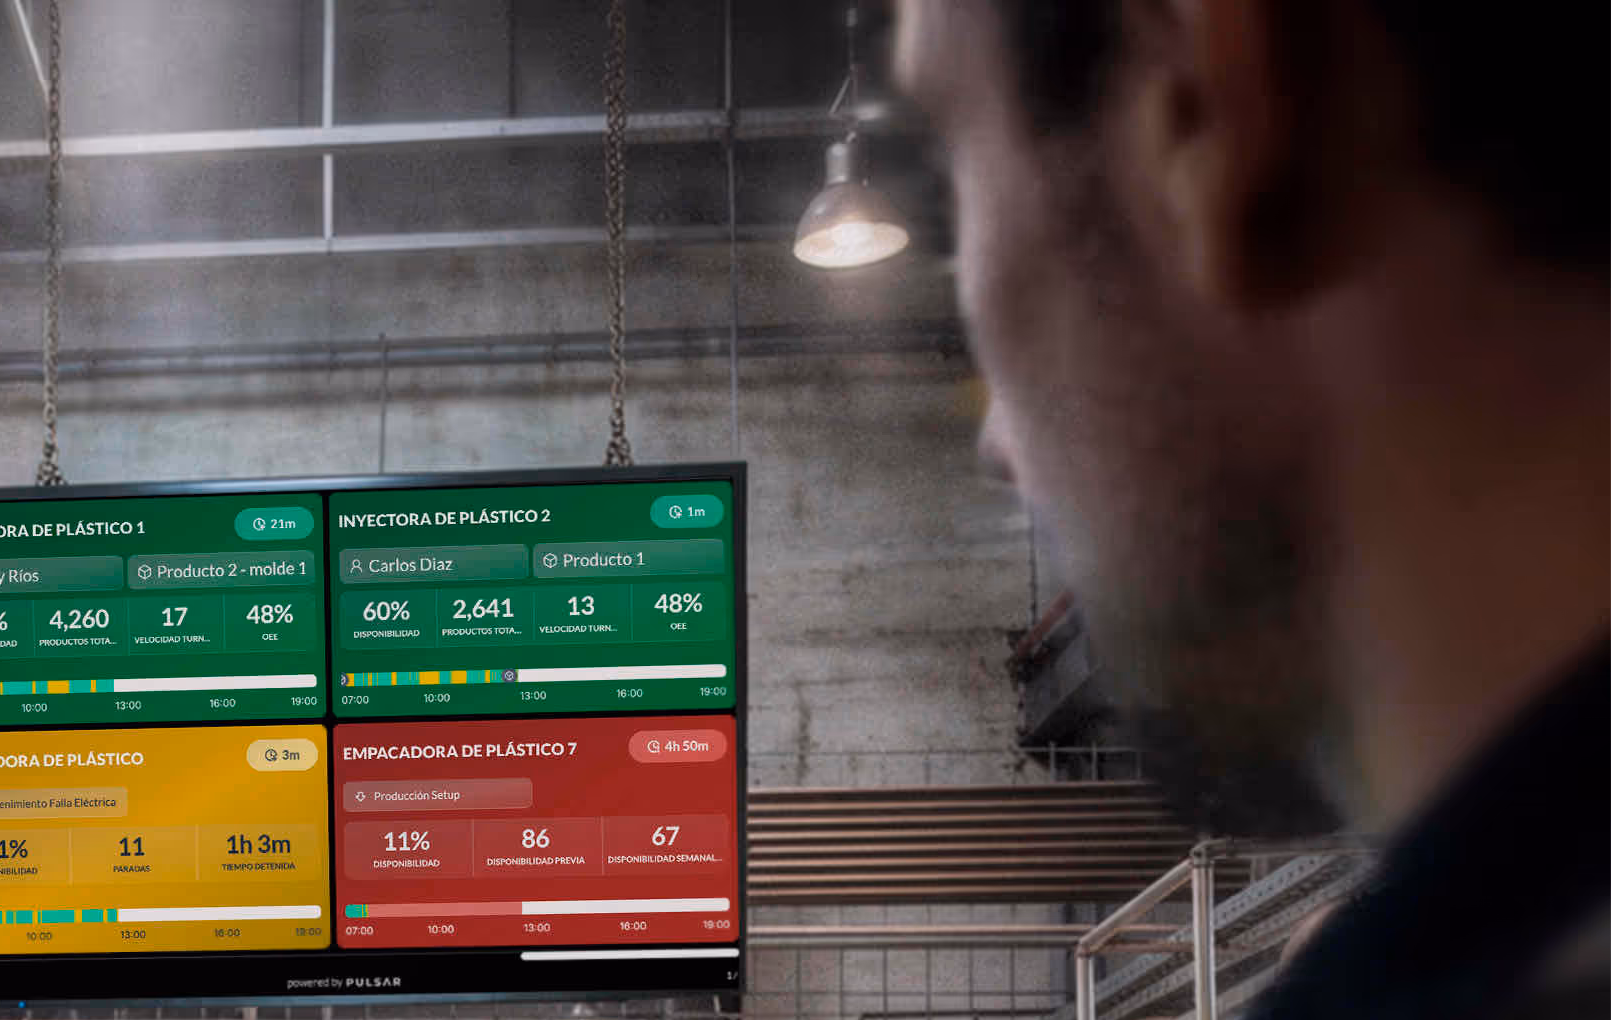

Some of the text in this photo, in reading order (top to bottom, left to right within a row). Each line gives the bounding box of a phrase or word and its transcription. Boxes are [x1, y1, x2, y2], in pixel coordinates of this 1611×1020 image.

[339, 508, 551, 528] INYECTORA DE PLÁSTICO 2
[687, 506, 705, 517] 1m
[32, 524, 53, 537] DE
[56, 520, 133, 536] PLÁSTICO
[138, 523, 145, 534] 1
[271, 518, 296, 530] 21m
[369, 559, 416, 573] Carlos
[563, 553, 644, 569] Producto 1
[8, 569, 39, 583] Ríos
[158, 564, 225, 580] Producto
[228, 564, 237, 577] 2
[249, 562, 295, 577] molde
[300, 562, 306, 574] 1
[363, 601, 410, 621] 60%
[452, 598, 514, 620] 2,641
[568, 596, 594, 616] 13
[654, 593, 703, 613] 48%
[50, 609, 109, 631] 4,260
[162, 607, 188, 627] 17
[247, 605, 293, 624] 48%
[354, 629, 420, 639] DISPONIBILIDAD
[442, 628, 492, 636] PRODUCTOS
[539, 625, 587, 633] VELOCIDAD
[671, 622, 687, 630] OEE
[39, 638, 87, 646] PRODUCTOS
[135, 636, 181, 644] VELOCIDAD
[342, 686, 726, 705] 07:00 10:00 13:00 16:00 19:00
[22, 703, 47, 713] 10:00
[115, 701, 141, 710] 13:00
[210, 698, 236, 708] 16:00
[291, 696, 317, 706] 19:00
[344, 742, 577, 760] EMPACADORA DE PLÁSTICO 7
[664, 741, 708, 752] 4h 50m
[44, 755, 63, 767] DE
[66, 751, 143, 767] PLÁSTICO
[282, 750, 300, 761] 3m
[374, 790, 460, 802] Producción Setup
[384, 831, 430, 851] 11%
[521, 829, 549, 848] 86
[652, 826, 679, 846] 67
[119, 837, 144, 856] 11
[227, 835, 290, 854] 1h 3m
[373, 859, 440, 868] DISPONIBILIDAD
[487, 856, 585, 866] DISPONIBILIDAD PREVIA
[608, 855, 675, 863] DISPONIBILIDAD
[120, 930, 146, 939] 13:00
[346, 926, 373, 936] 07:00
[428, 925, 455, 934] 10:00
[524, 922, 551, 932] 13:00
[287, 976, 401, 990] powered by PULSAR
